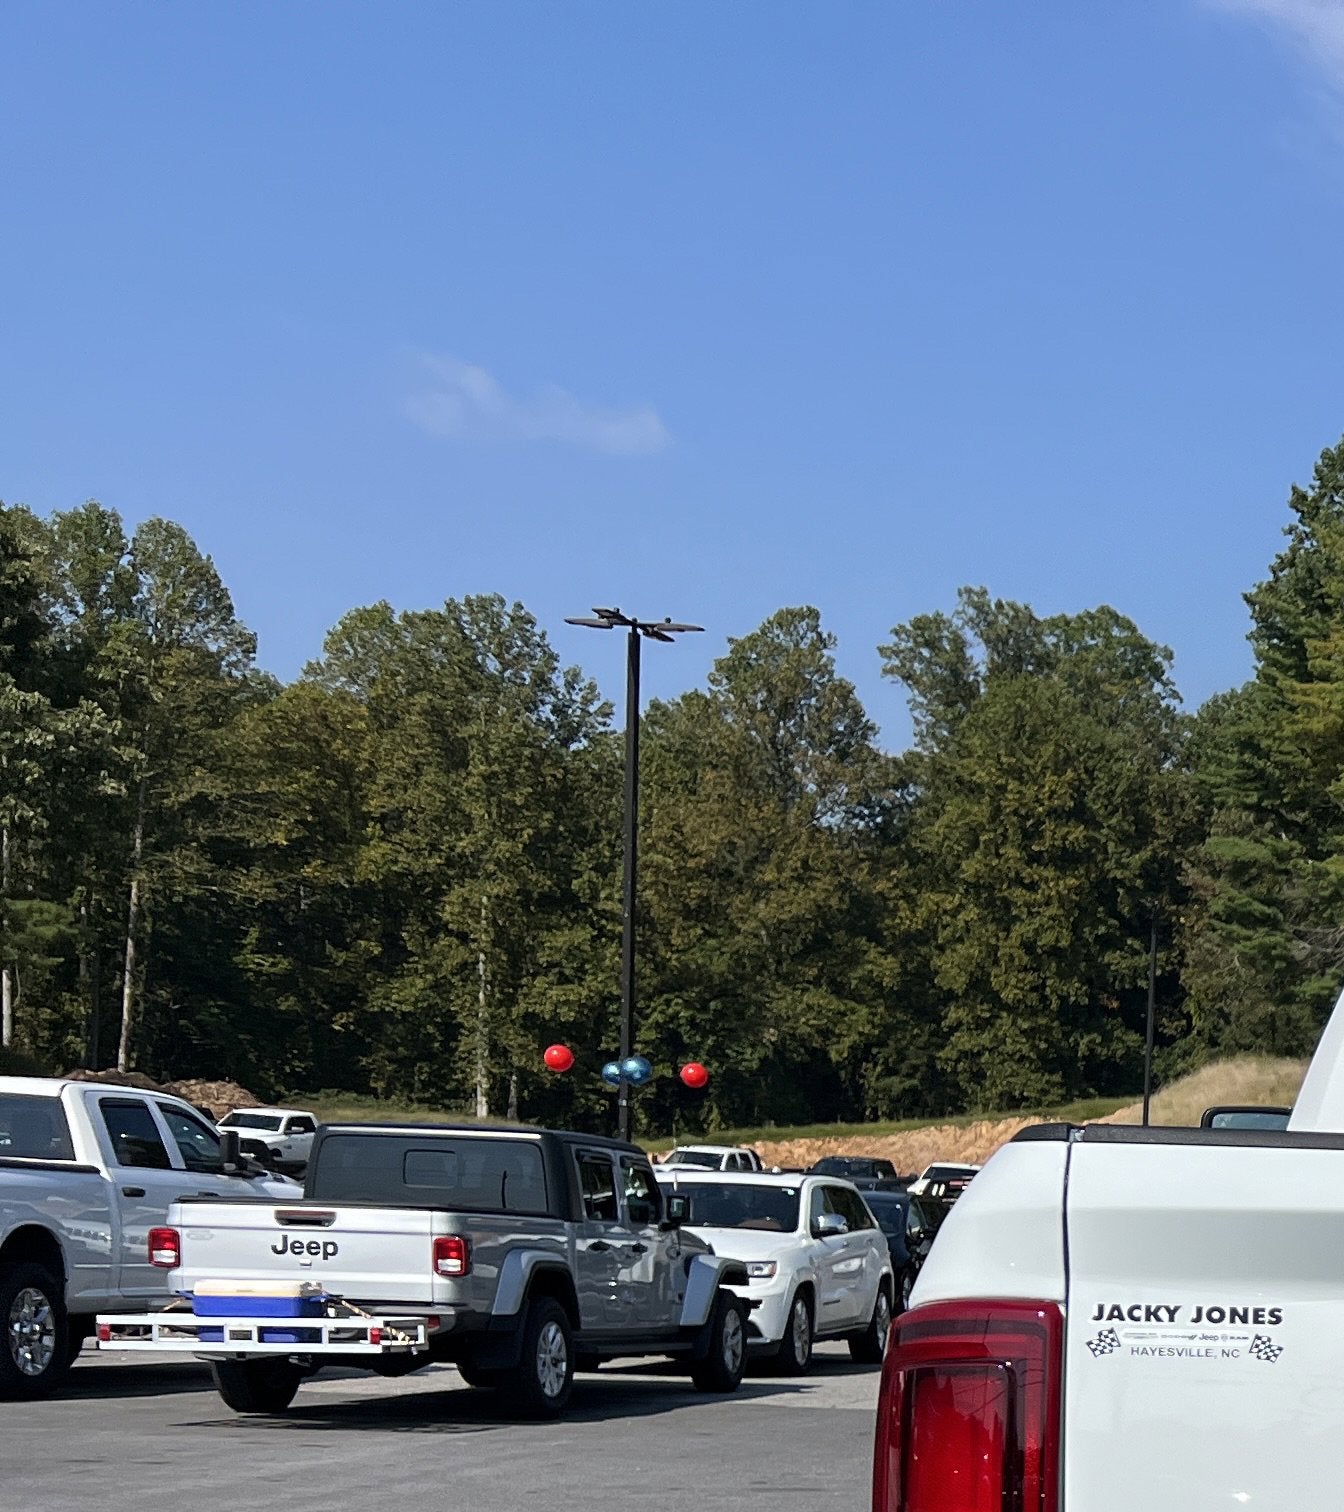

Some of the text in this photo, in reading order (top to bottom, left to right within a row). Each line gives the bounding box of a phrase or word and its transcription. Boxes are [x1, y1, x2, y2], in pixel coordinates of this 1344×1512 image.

[271, 1234, 339, 1261] Jeep
[1091, 1303, 1284, 1325] JACKY JONES
[1130, 1346, 1241, 1360] HAYESVILLE, NC
